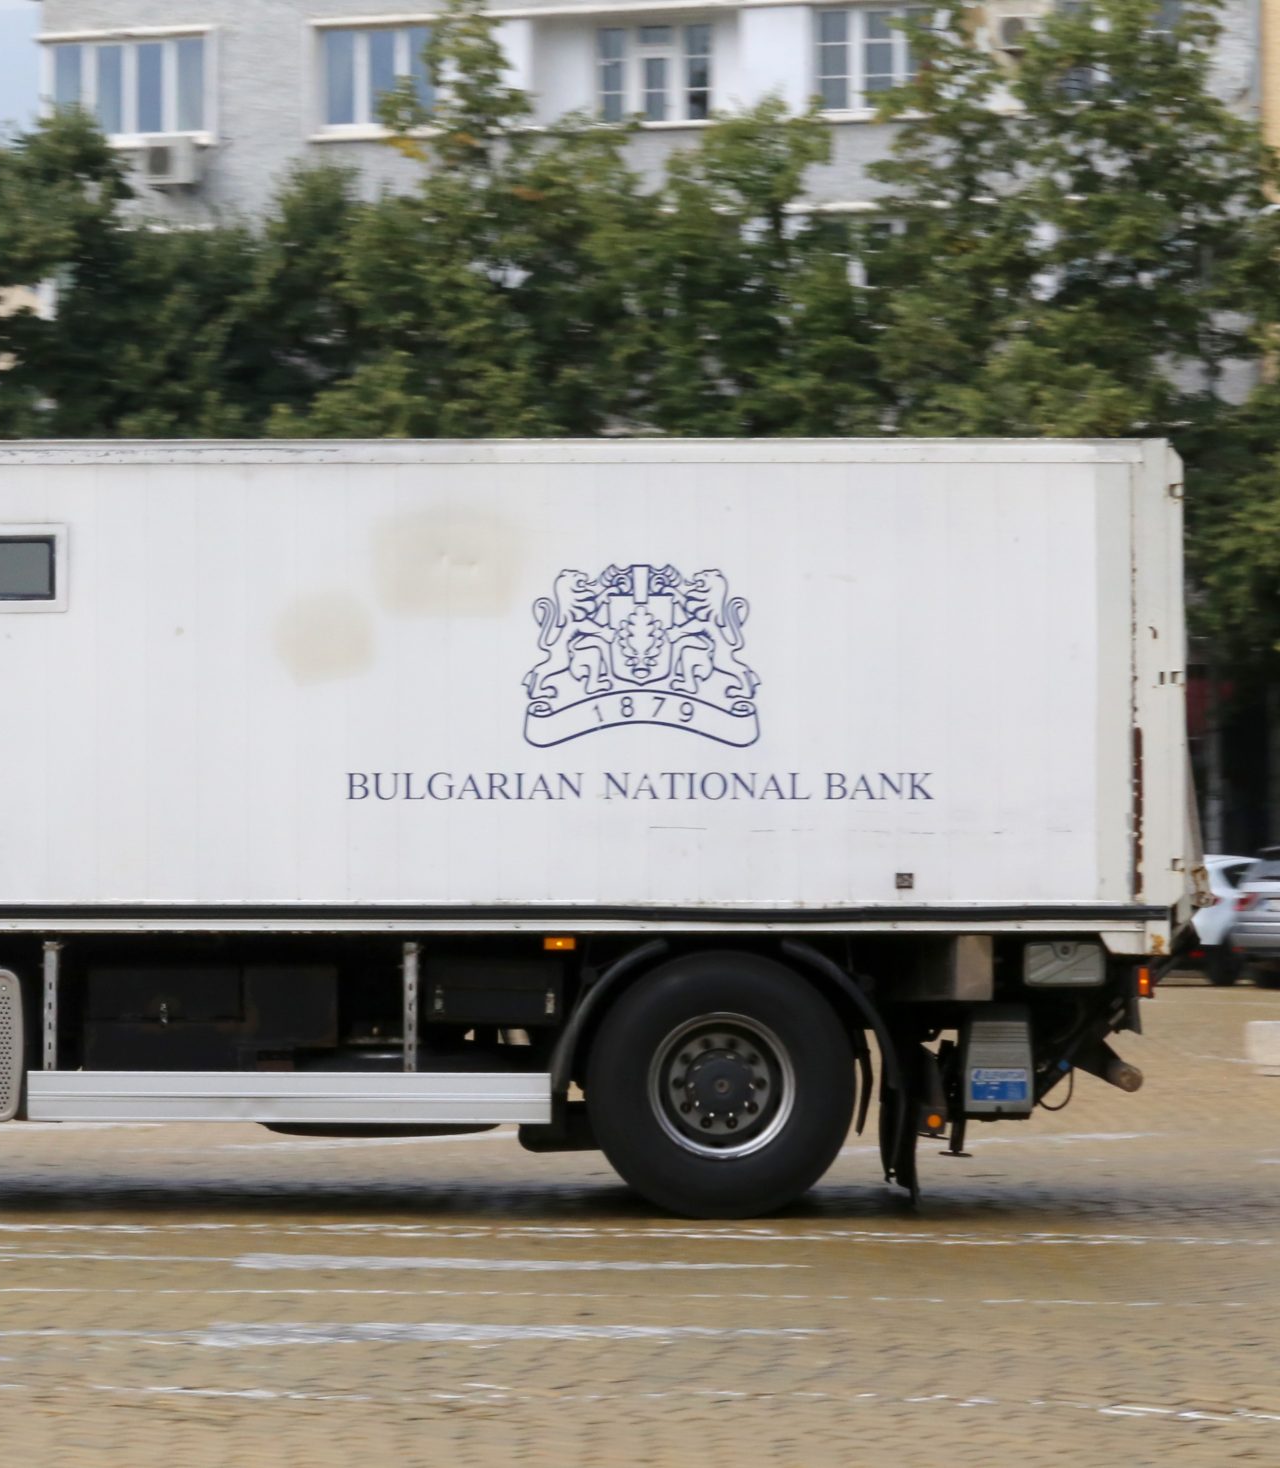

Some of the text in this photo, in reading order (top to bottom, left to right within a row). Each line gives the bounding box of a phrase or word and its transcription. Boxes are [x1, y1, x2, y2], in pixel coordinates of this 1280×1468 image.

[593, 696, 694, 722] 1879
[346, 771, 934, 801] BULGARIAN NATIONAL BANK
